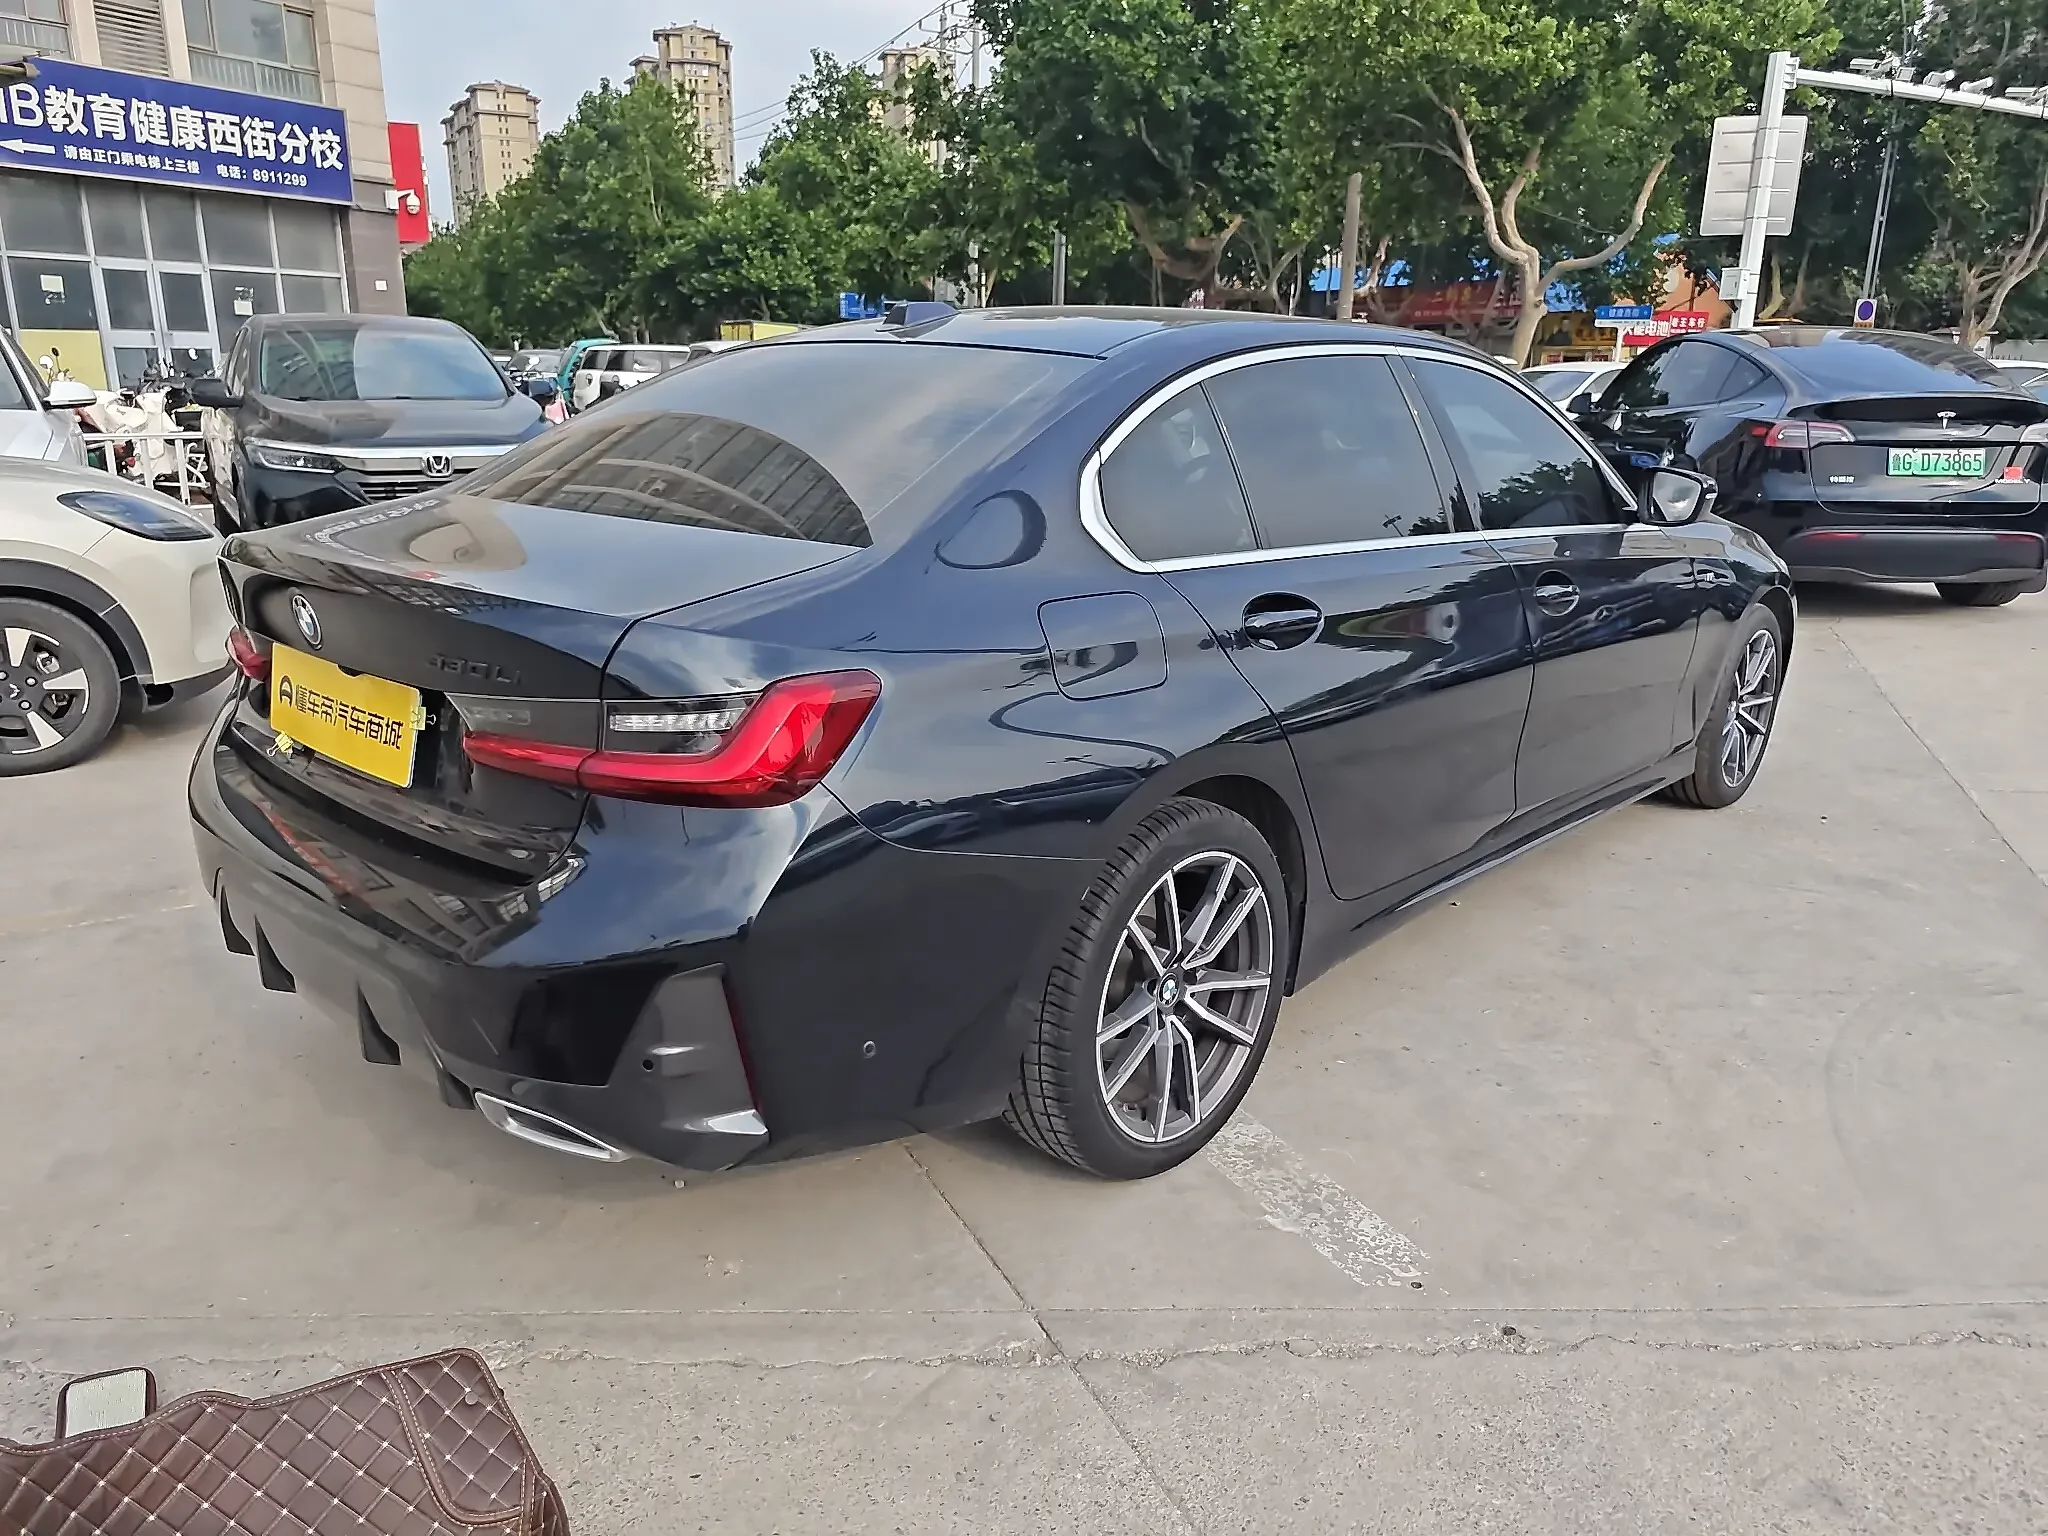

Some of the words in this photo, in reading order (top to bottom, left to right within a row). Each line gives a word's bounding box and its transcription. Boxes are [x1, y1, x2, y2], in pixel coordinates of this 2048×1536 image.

[0, 83, 344, 170] B教育健康西街分校
